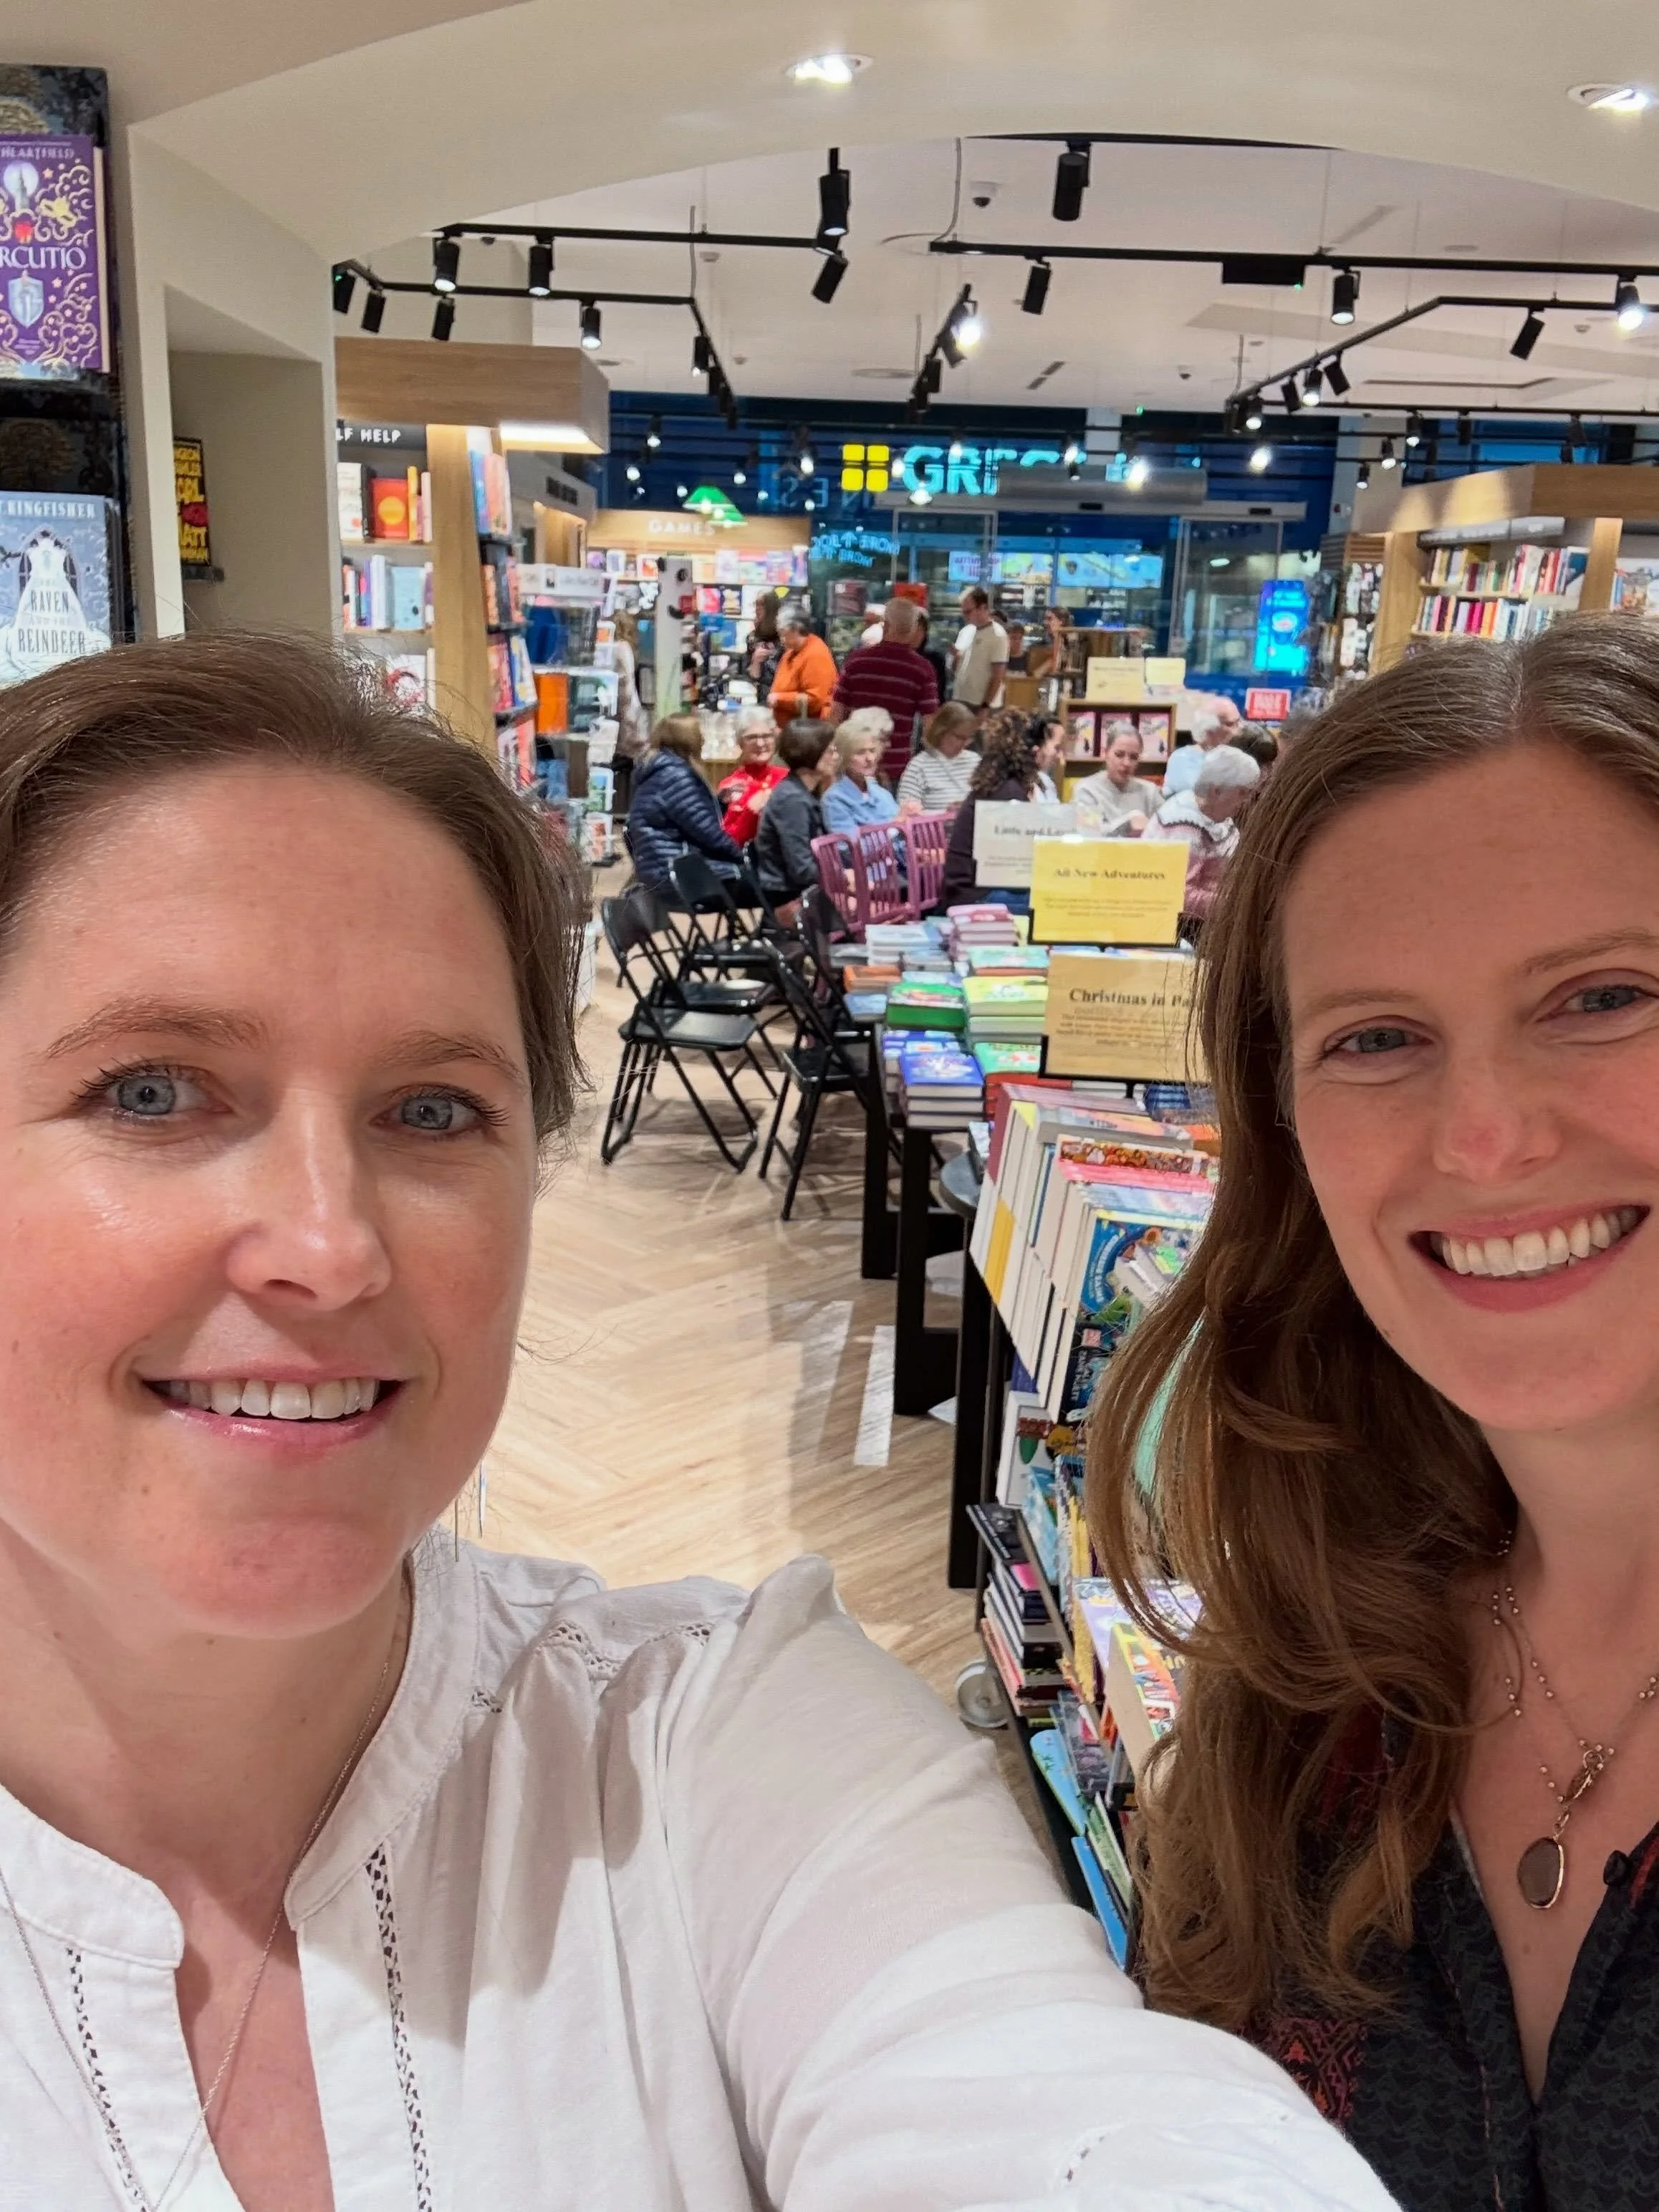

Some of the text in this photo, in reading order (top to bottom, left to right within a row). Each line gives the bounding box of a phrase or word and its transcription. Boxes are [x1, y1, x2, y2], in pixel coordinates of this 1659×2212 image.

[360, 428, 401, 443] HELP
[7, 500, 95, 519] KINGFISHER
[648, 518, 716, 537] GAMES
[30, 590, 69, 613] RAVEN
[18, 628, 86, 655] REINDEER
[1075, 869, 1097, 879] New
[1101, 869, 1165, 880] Adventures
[1069, 988, 1148, 1006] Christmas
[1152, 992, 1165, 1006] in
